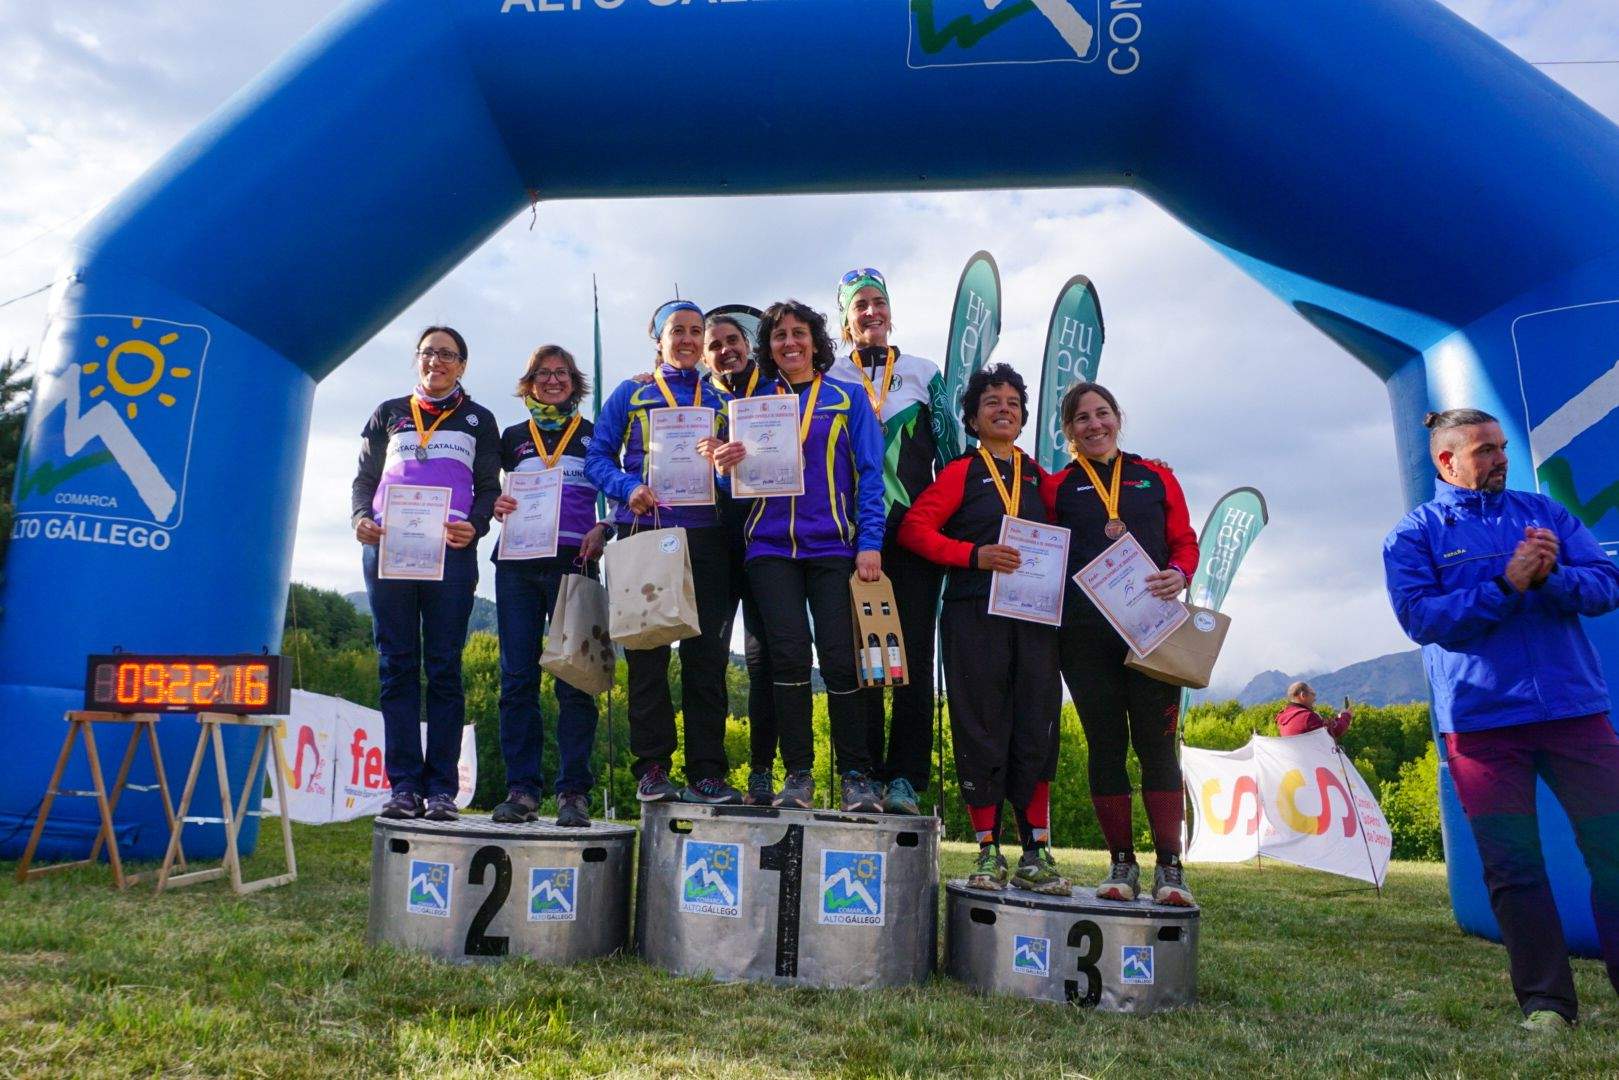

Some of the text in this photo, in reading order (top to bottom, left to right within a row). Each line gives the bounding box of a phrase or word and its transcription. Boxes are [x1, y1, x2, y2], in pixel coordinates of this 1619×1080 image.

[11, 514, 171, 551] LTO GÁLLEGO
[55, 493, 118, 508] COMARCA
[116, 663, 270, 705] 09:22:16
[465, 845, 513, 956] 2
[760, 824, 804, 977] 1
[1065, 919, 1104, 1007] 3
